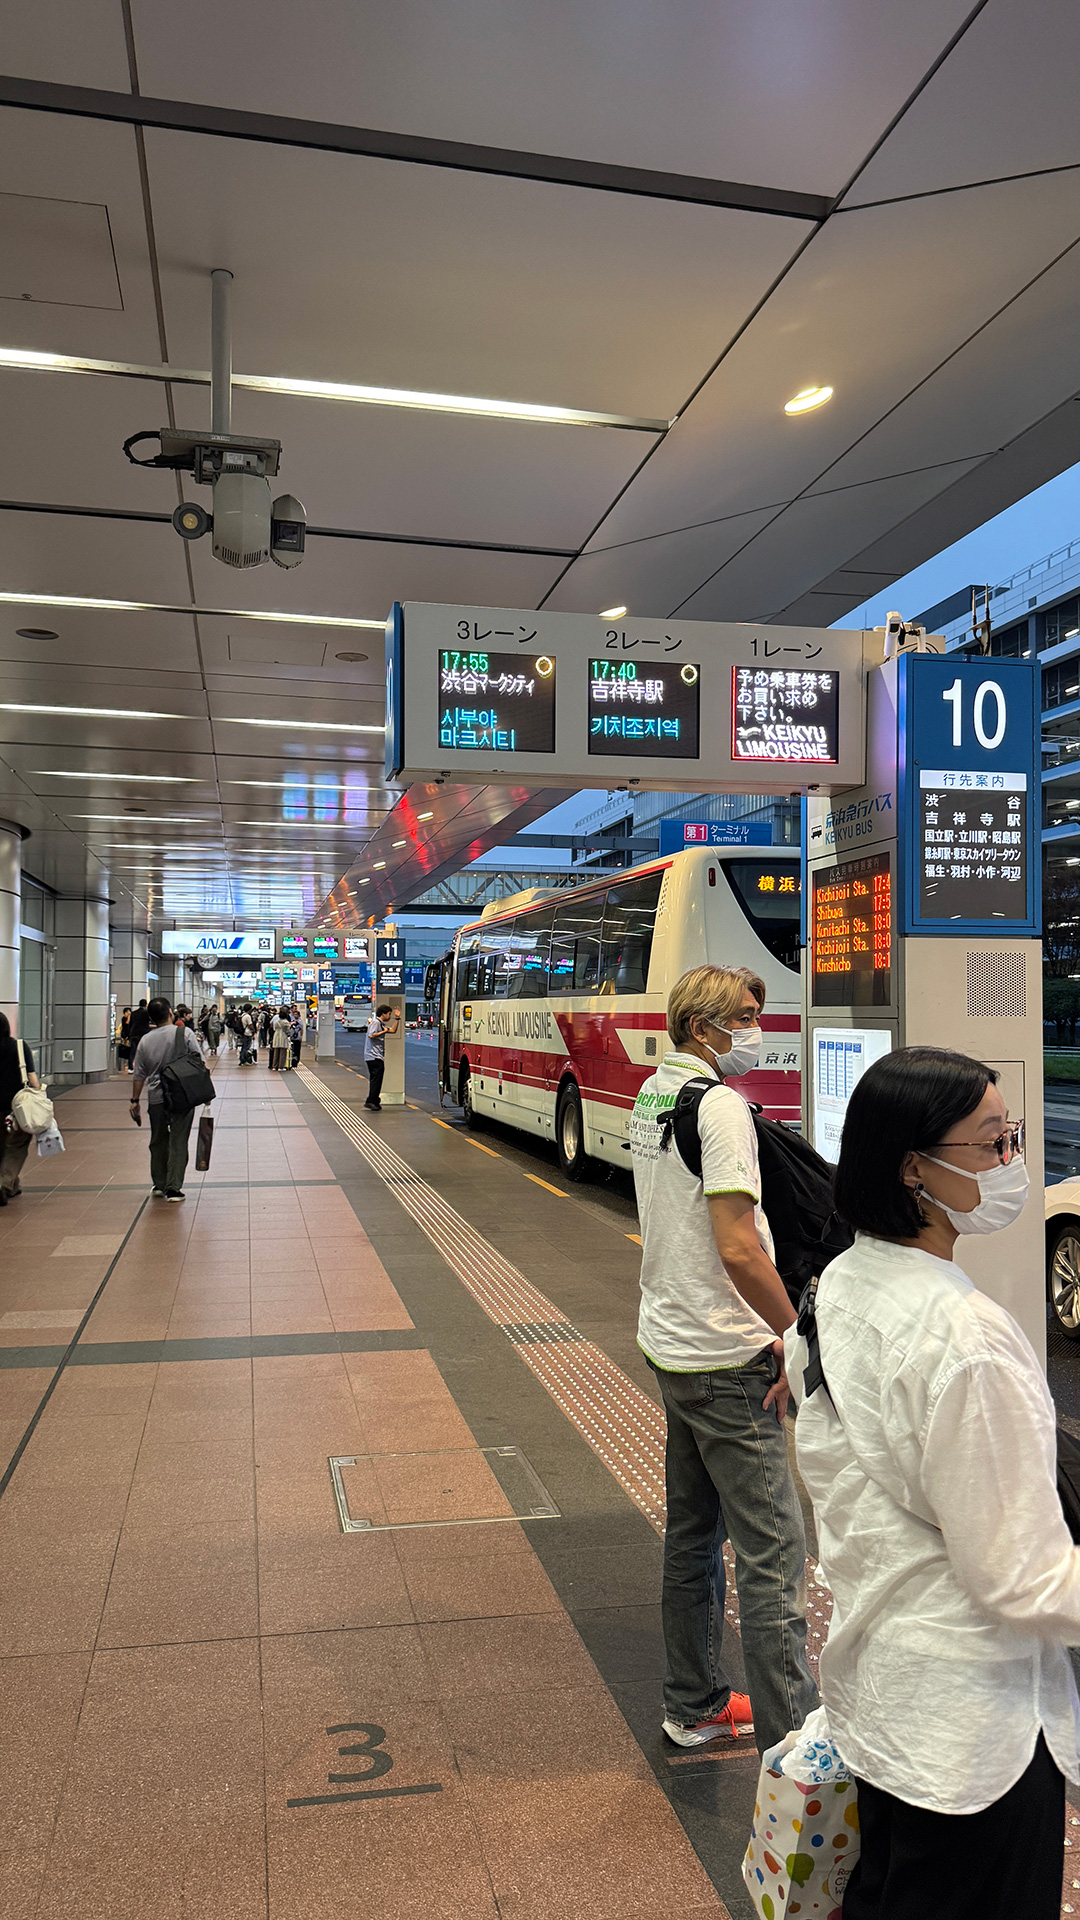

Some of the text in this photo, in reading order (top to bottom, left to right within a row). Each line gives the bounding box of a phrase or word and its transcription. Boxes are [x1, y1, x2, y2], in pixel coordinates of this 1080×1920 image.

[457, 620, 538, 643] 3レーン
[605, 630, 682, 652] 2レーン
[750, 638, 823, 659] 1レーン
[442, 651, 489, 672] 17:55
[592, 661, 636, 681] 17:40
[441, 668, 535, 696] 渋谷マークシティ
[737, 669, 833, 690] 予め乗車券を
[591, 678, 664, 704] 吉祥寺駅
[737, 687, 818, 708] お買い求め
[441, 707, 498, 730] 시부야
[942, 678, 1007, 750] 10
[590, 715, 680, 740] 기치조지역
[762, 724, 827, 743] KEIKYU
[441, 726, 516, 752] 마크시티
[736, 740, 831, 760] LIMOUSINE
[943, 773, 1004, 788] 行先案内
[825, 793, 892, 829] 京浜急行バス
[686, 824, 750, 839] 第1 ターミナル
[712, 834, 741, 843] Terminal
[825, 819, 873, 845] KEIKYU BUS
[758, 875, 801, 892] 横浜
[816, 884, 850, 904] Kichijoji
[853, 881, 869, 896] Sta.
[873, 873, 891, 893] 17:4
[816, 893, 891, 921] Shibuya 17:5
[816, 913, 891, 938] Kunitachi Sta. 18:0
[196, 938, 228, 950] ANA
[384, 942, 398, 957] 11
[816, 939, 850, 956] Kichijoji
[853, 936, 869, 951] Sta.
[873, 932, 891, 950] 18:0
[816, 956, 851, 973] Kinshicho
[873, 952, 891, 969] 18:1
[322, 970, 332, 980] 12
[488, 1012, 552, 1039] KEIKYU LIMOUSINE
[765, 1052, 798, 1064] 京浜
[326, 1723, 394, 1783] 3
